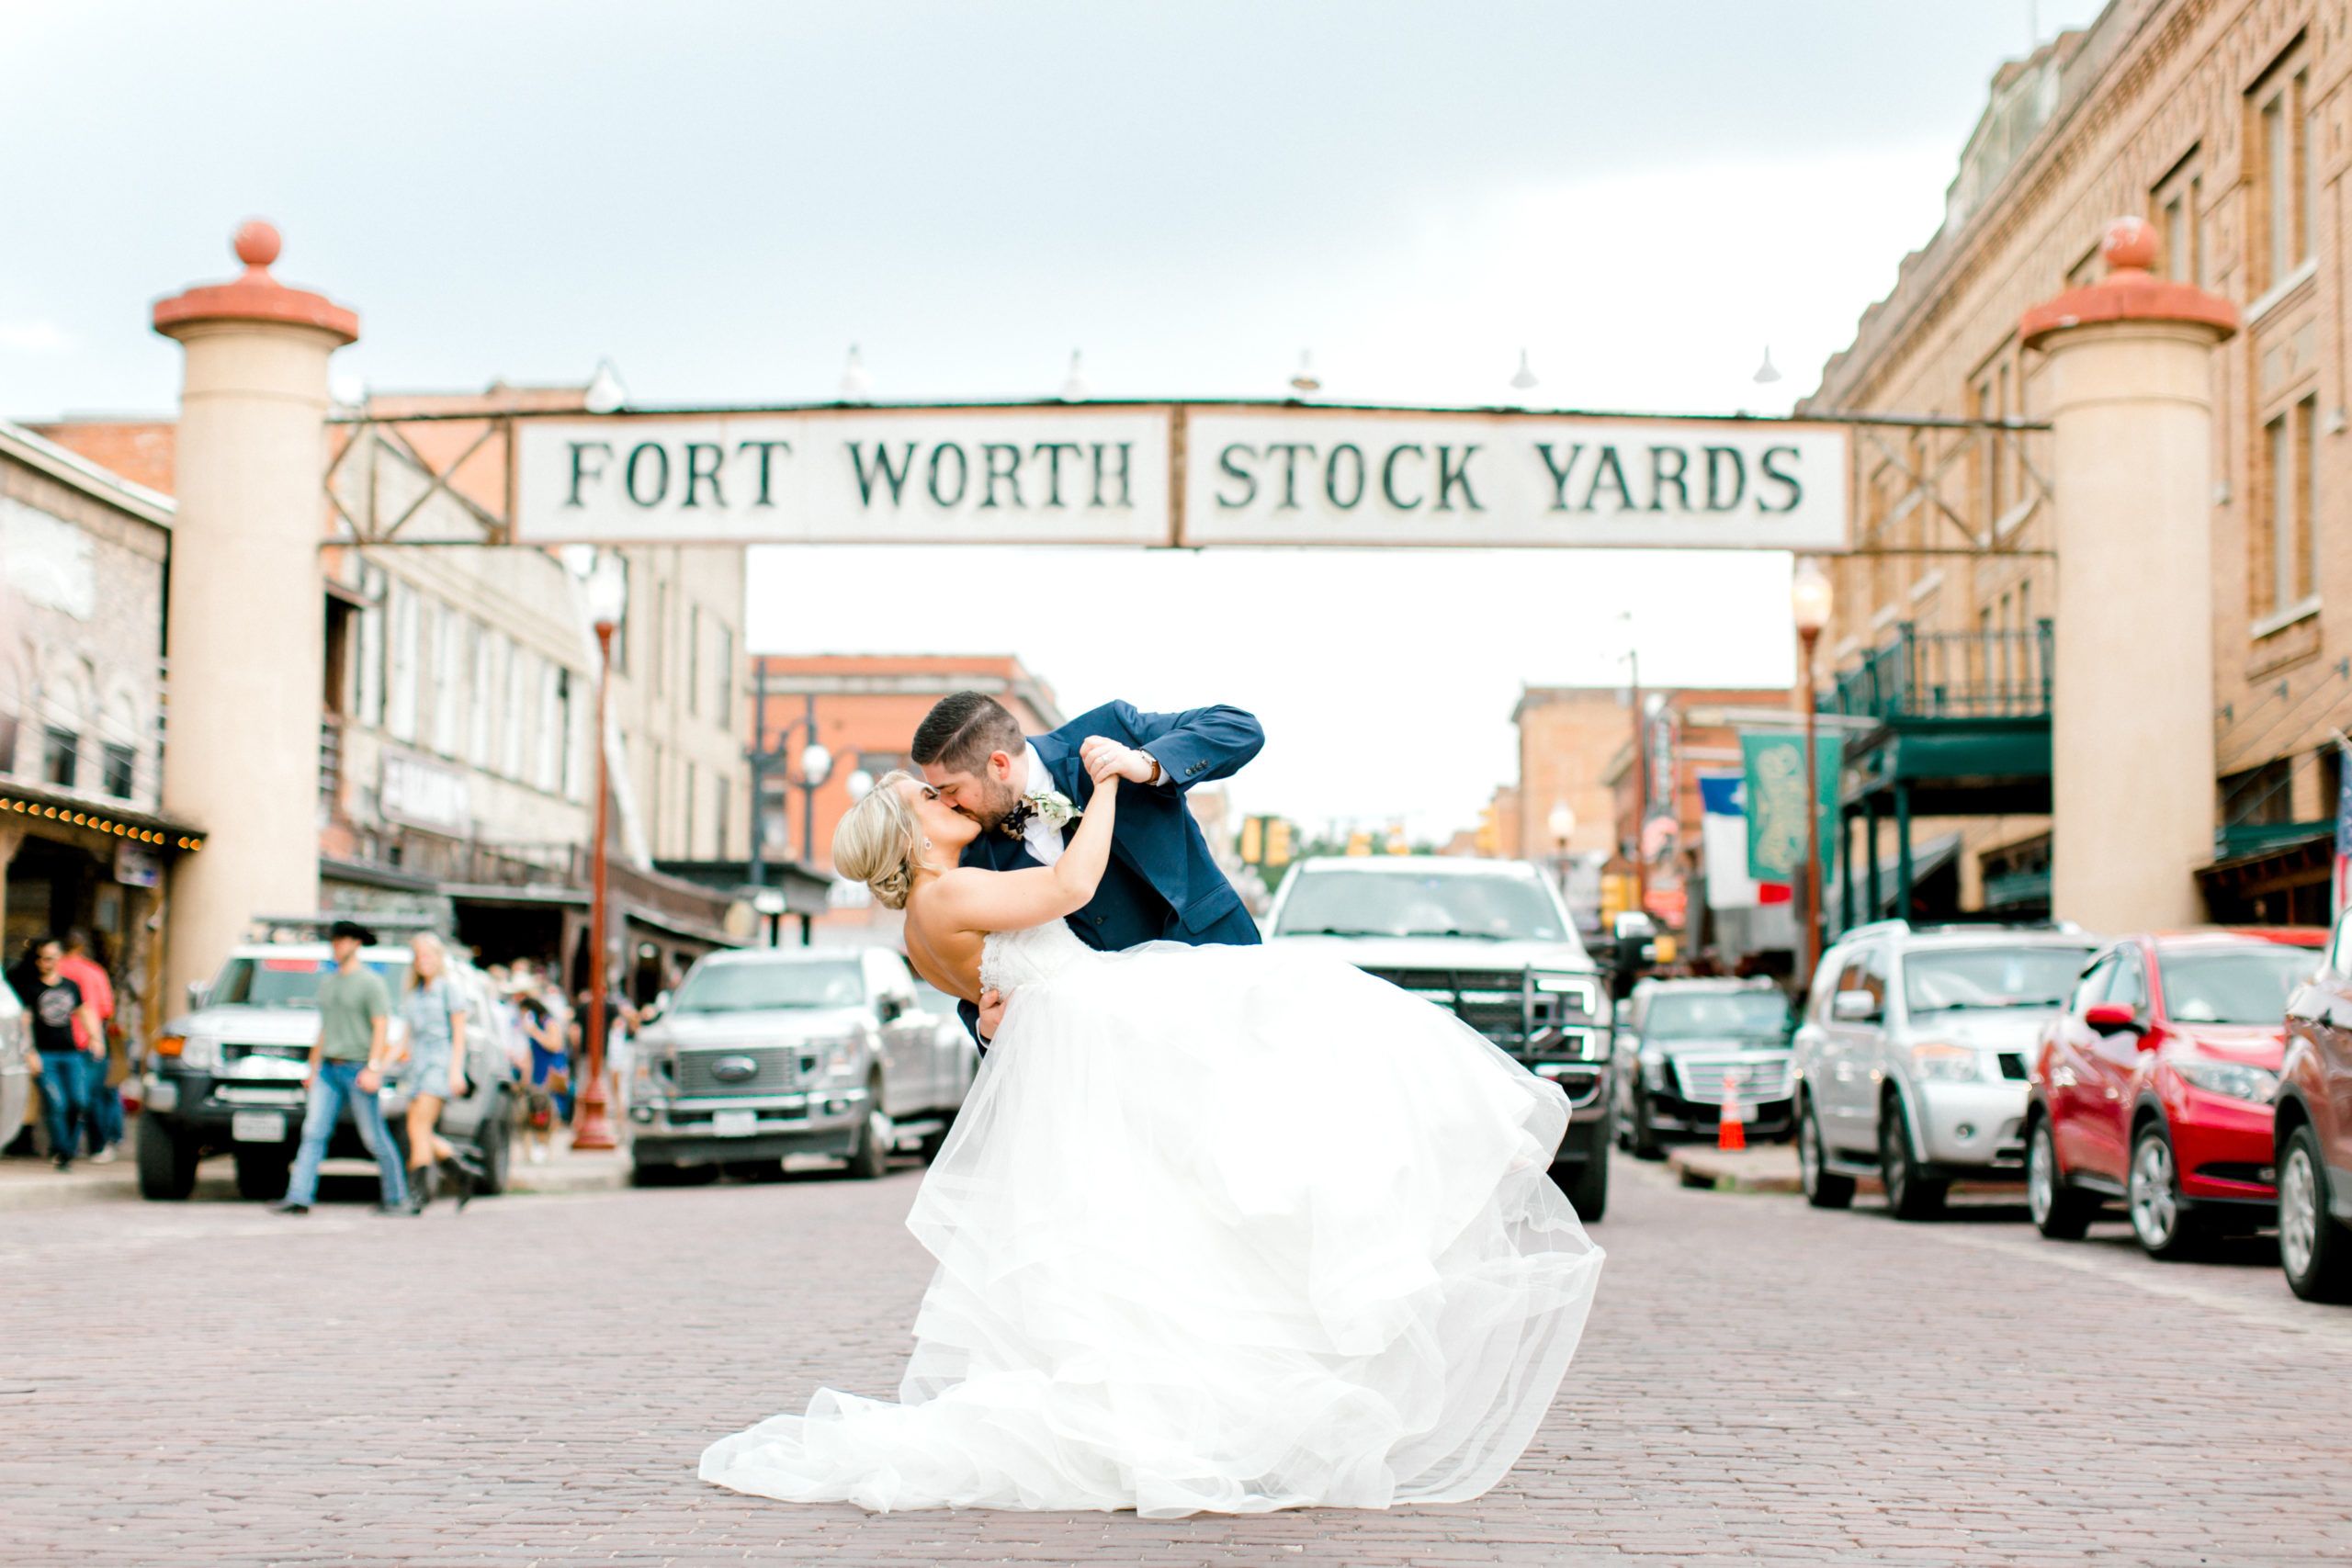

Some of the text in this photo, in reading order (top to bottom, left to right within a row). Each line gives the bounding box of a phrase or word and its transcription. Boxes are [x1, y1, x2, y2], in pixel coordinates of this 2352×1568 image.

[565, 441, 1803, 513] FORT WORTH STOCK YARDS
